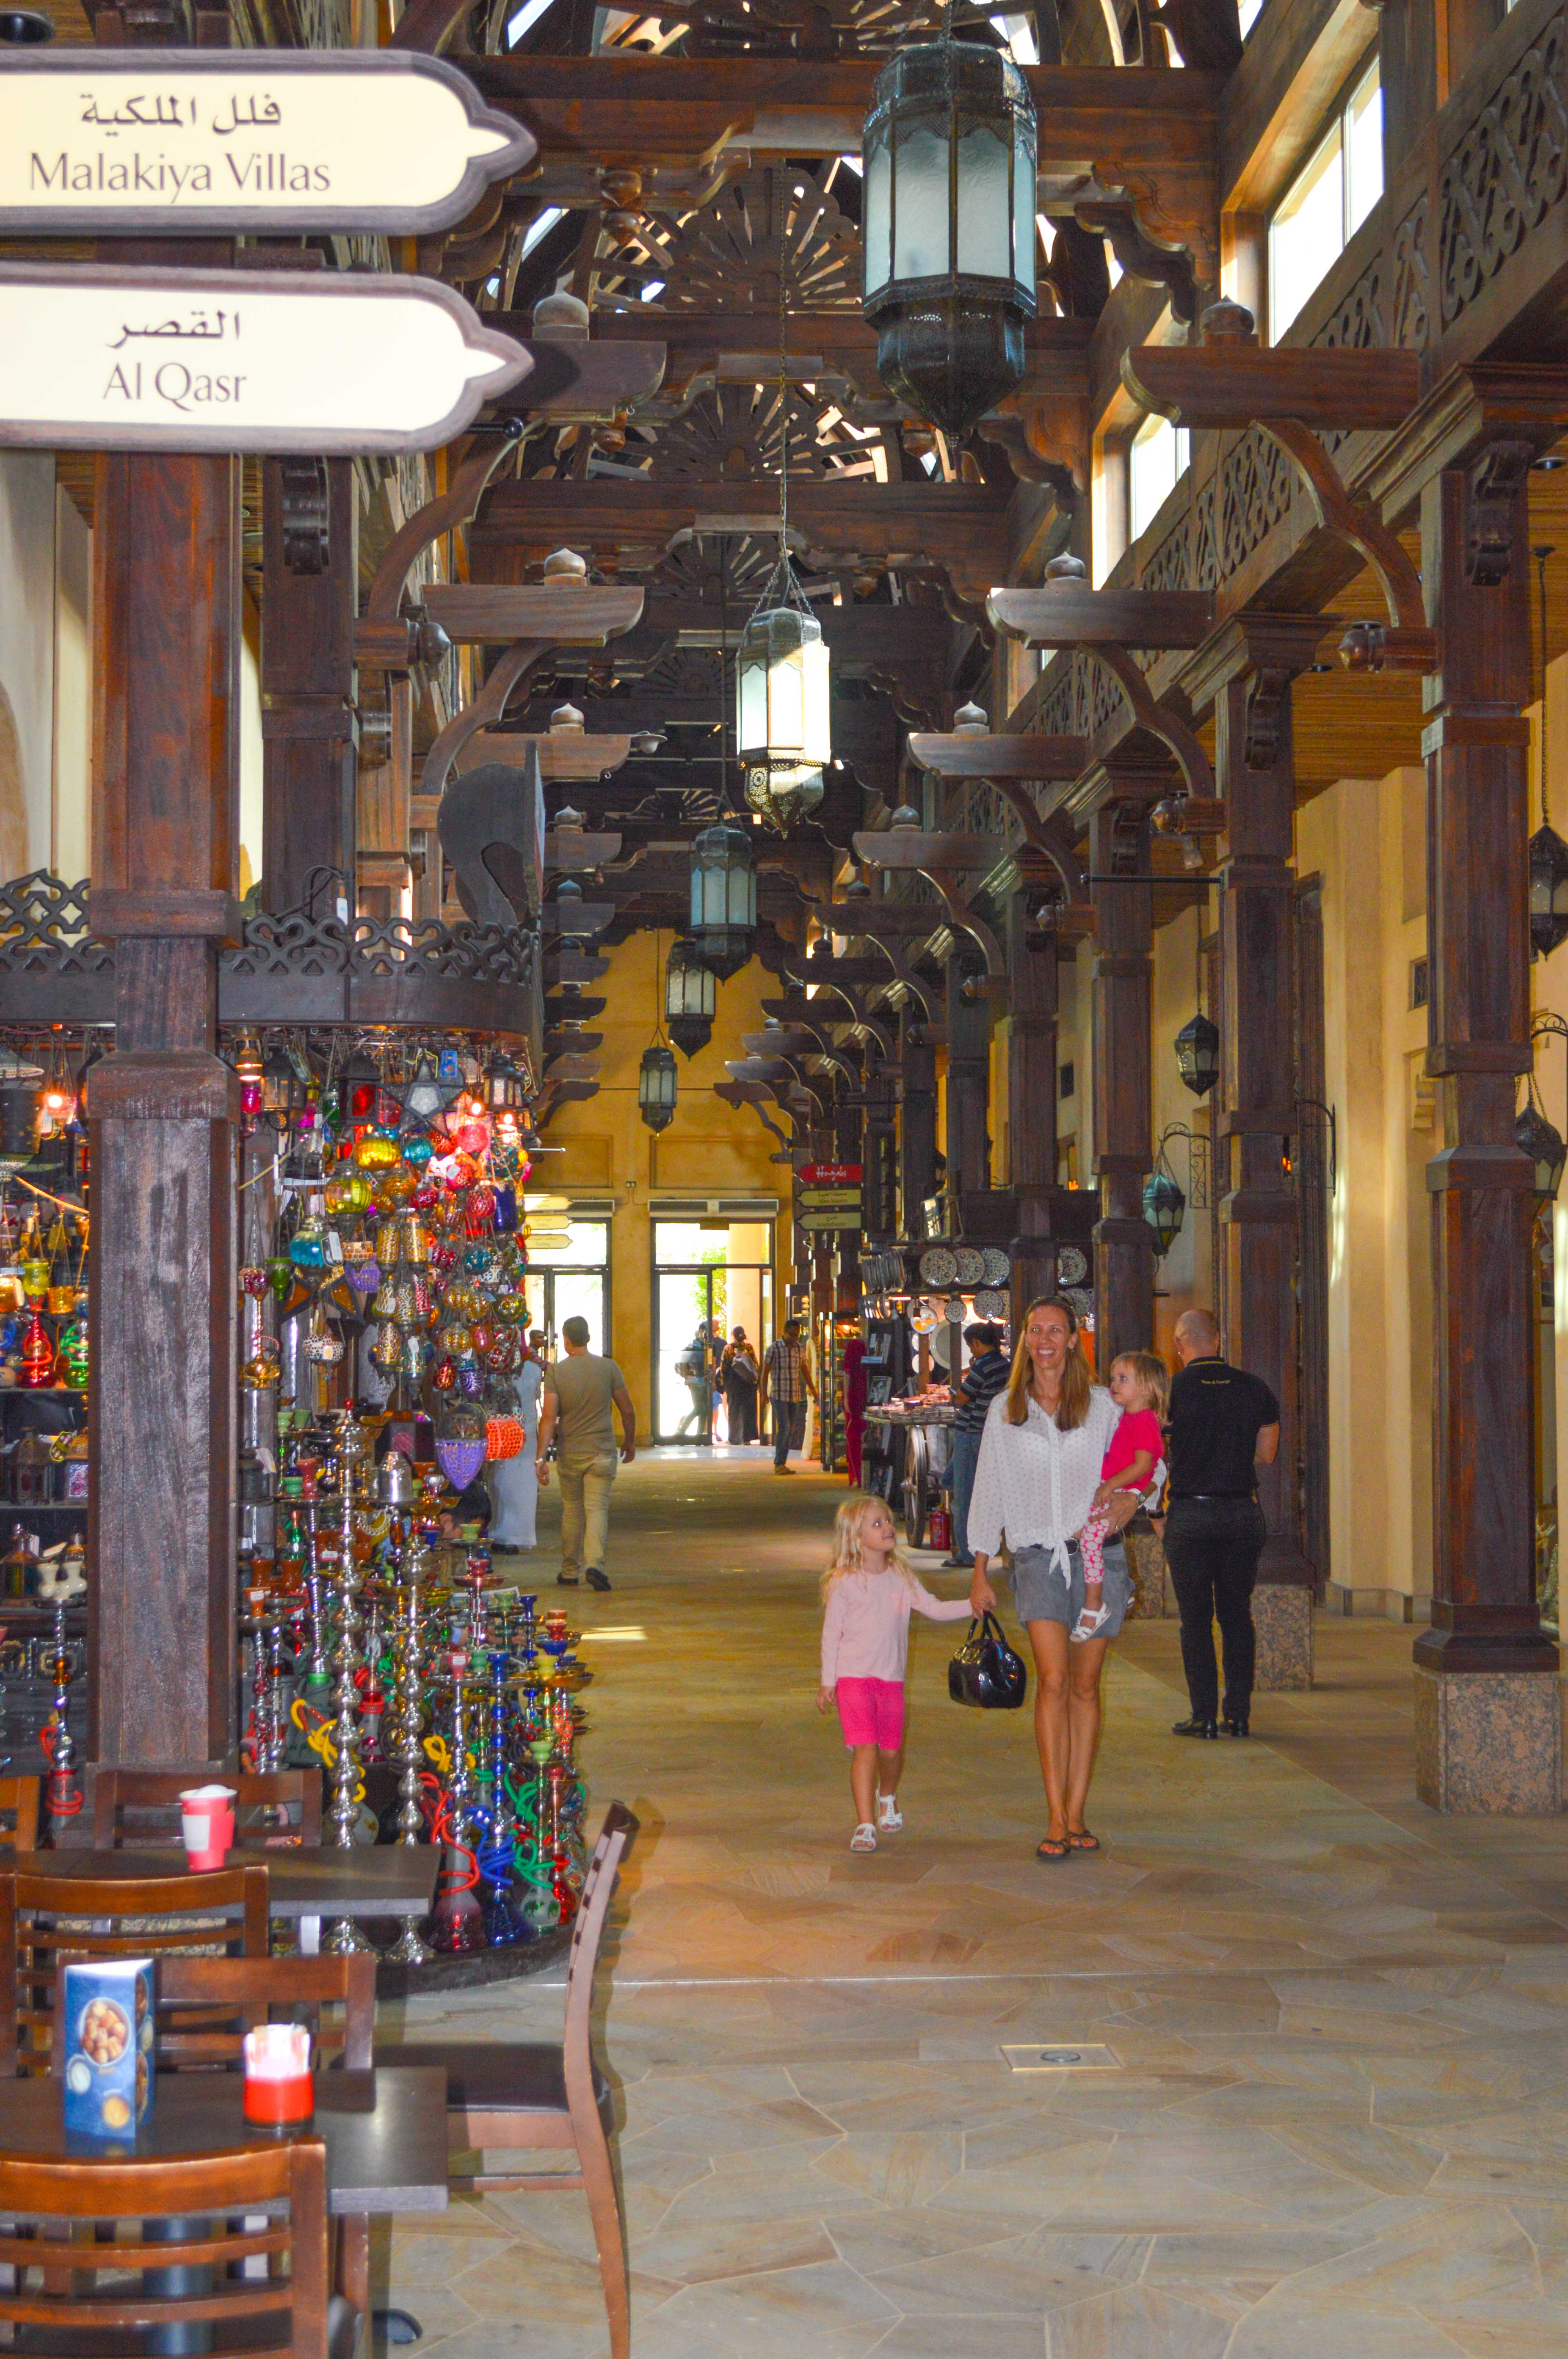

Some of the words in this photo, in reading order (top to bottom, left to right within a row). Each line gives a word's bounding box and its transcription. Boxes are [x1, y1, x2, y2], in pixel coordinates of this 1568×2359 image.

[80, 93, 196, 137] الملكية
[212, 93, 282, 135] فلل
[30, 152, 212, 204] Malakiya
[225, 153, 330, 191] Villas
[105, 310, 241, 349] القصر
[103, 363, 142, 400] Al
[154, 363, 248, 411] Qasr
